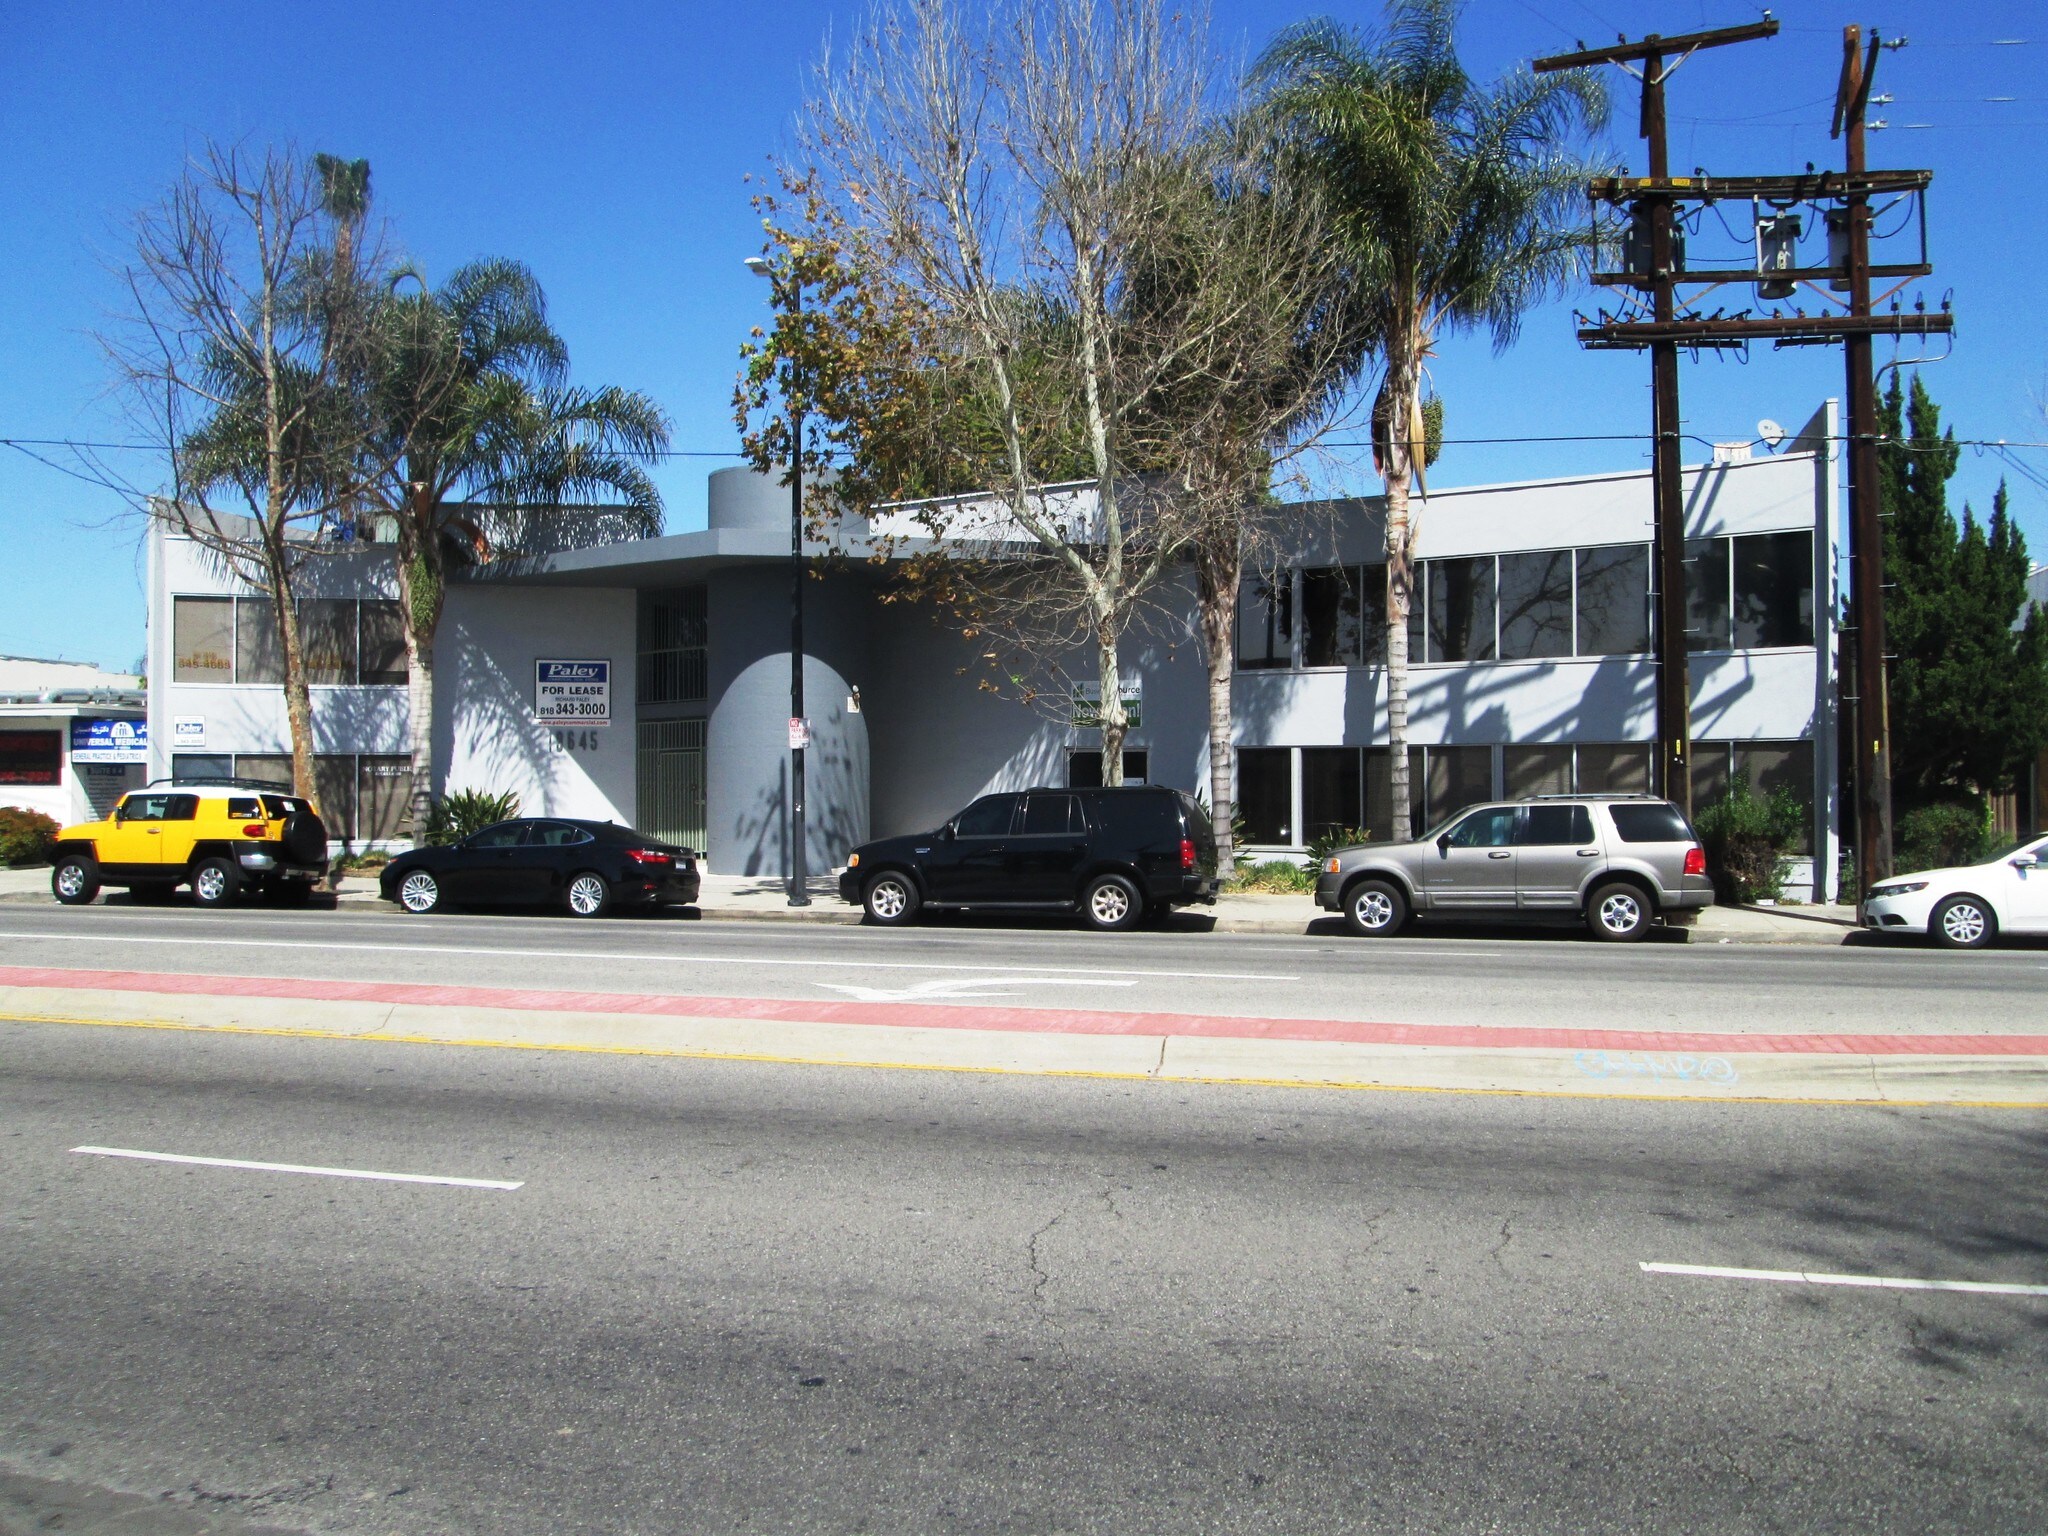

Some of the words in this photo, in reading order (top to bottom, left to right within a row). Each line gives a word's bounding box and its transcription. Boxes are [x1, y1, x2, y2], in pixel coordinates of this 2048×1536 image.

[548, 664, 599, 677] Paley
[542, 686, 564, 695] FOR
[569, 686, 604, 695] LEASE
[540, 707, 554, 715] 818
[556, 703, 606, 715] 343-3000
[73, 738, 114, 746] UNIVERSAL
[115, 738, 147, 746] MEDICAL
